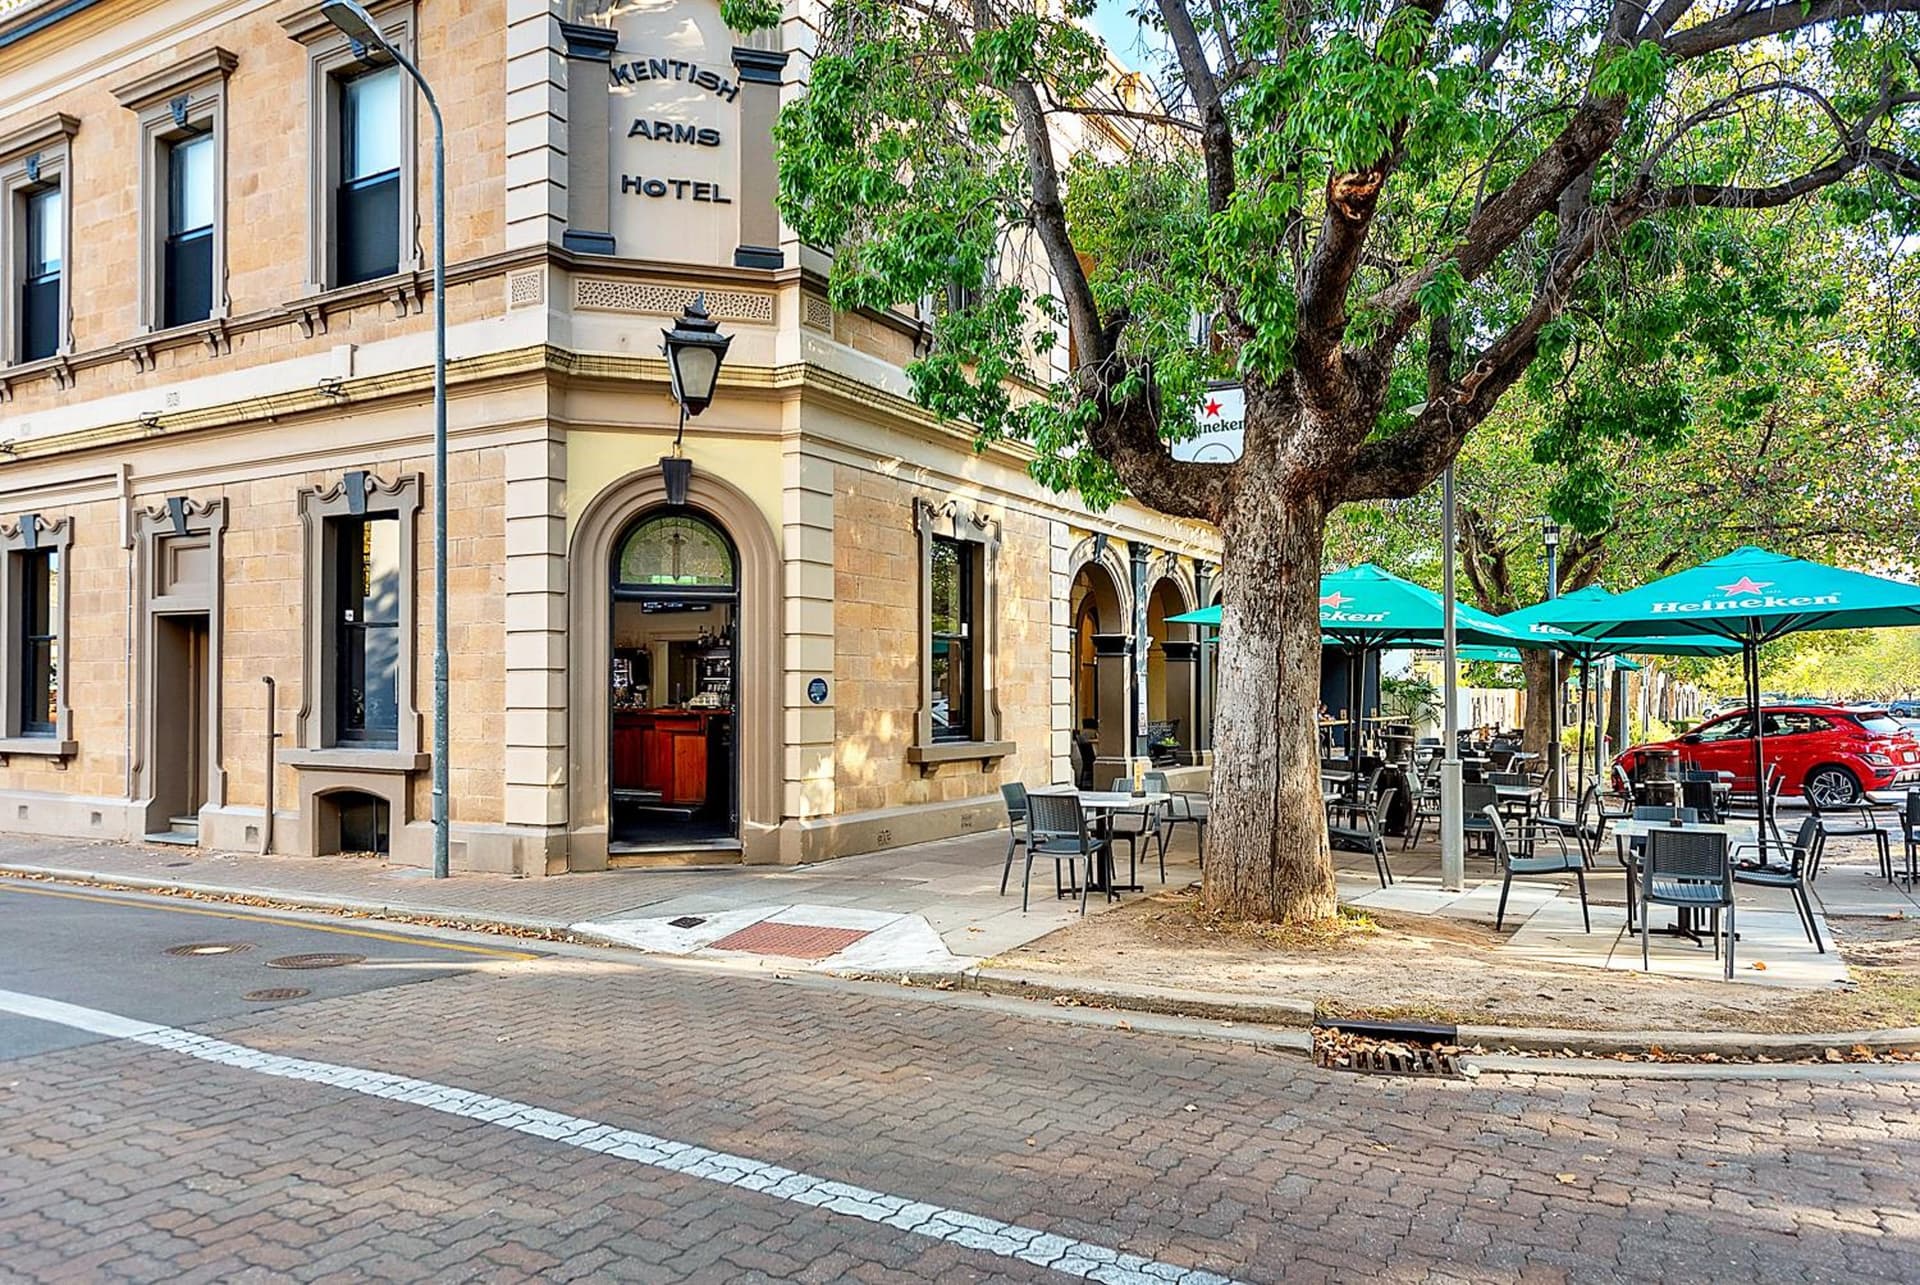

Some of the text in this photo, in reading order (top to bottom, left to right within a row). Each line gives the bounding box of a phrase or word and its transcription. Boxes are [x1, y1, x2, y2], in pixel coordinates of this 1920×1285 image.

[611, 58, 740, 103] KENTISH
[627, 118, 721, 147] ARMS
[621, 174, 732, 204] HOTEL
[1199, 419, 1244, 434] ineke
[1319, 610, 1385, 622] eken
[1650, 595, 1841, 614] Heineken
